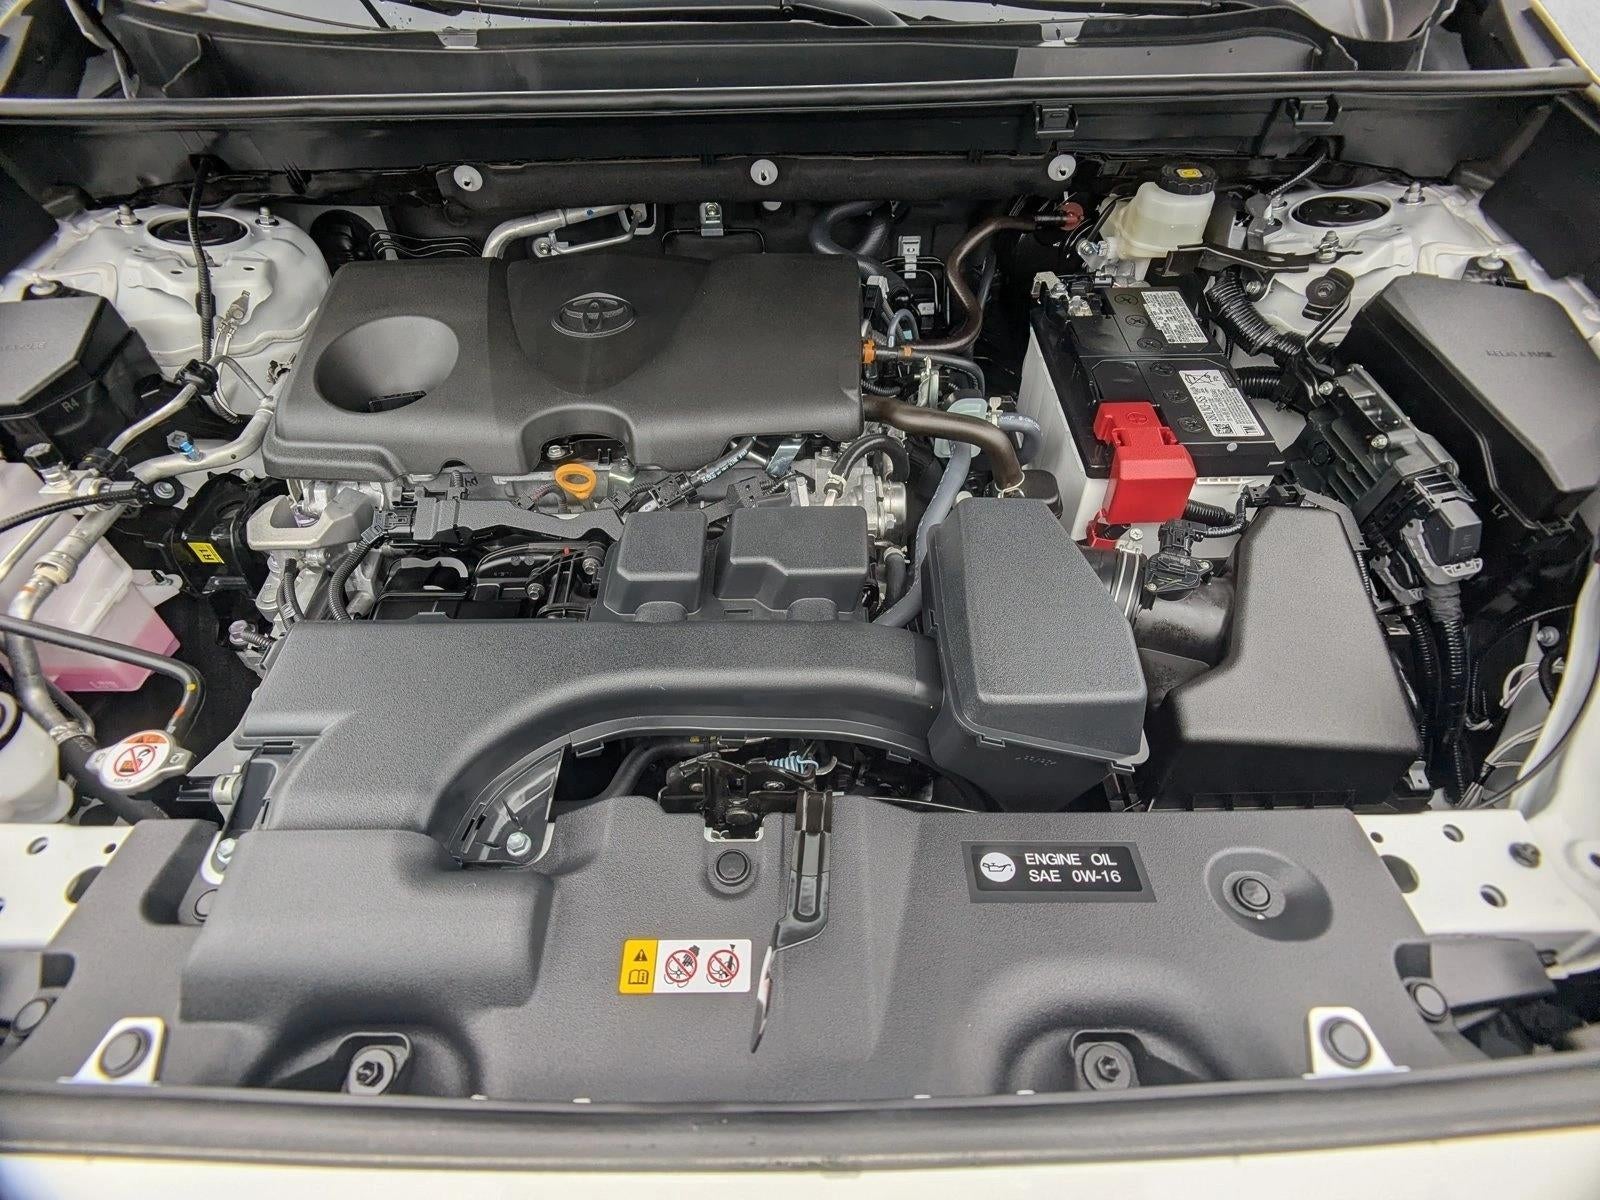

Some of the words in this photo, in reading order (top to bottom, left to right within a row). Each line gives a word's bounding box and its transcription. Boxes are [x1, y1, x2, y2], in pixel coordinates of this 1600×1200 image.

[1024, 853, 1082, 866] ENGINE
[1090, 853, 1118, 866] OIL
[1029, 869, 1062, 883] SAE
[1072, 869, 1122, 883] 0W-16
